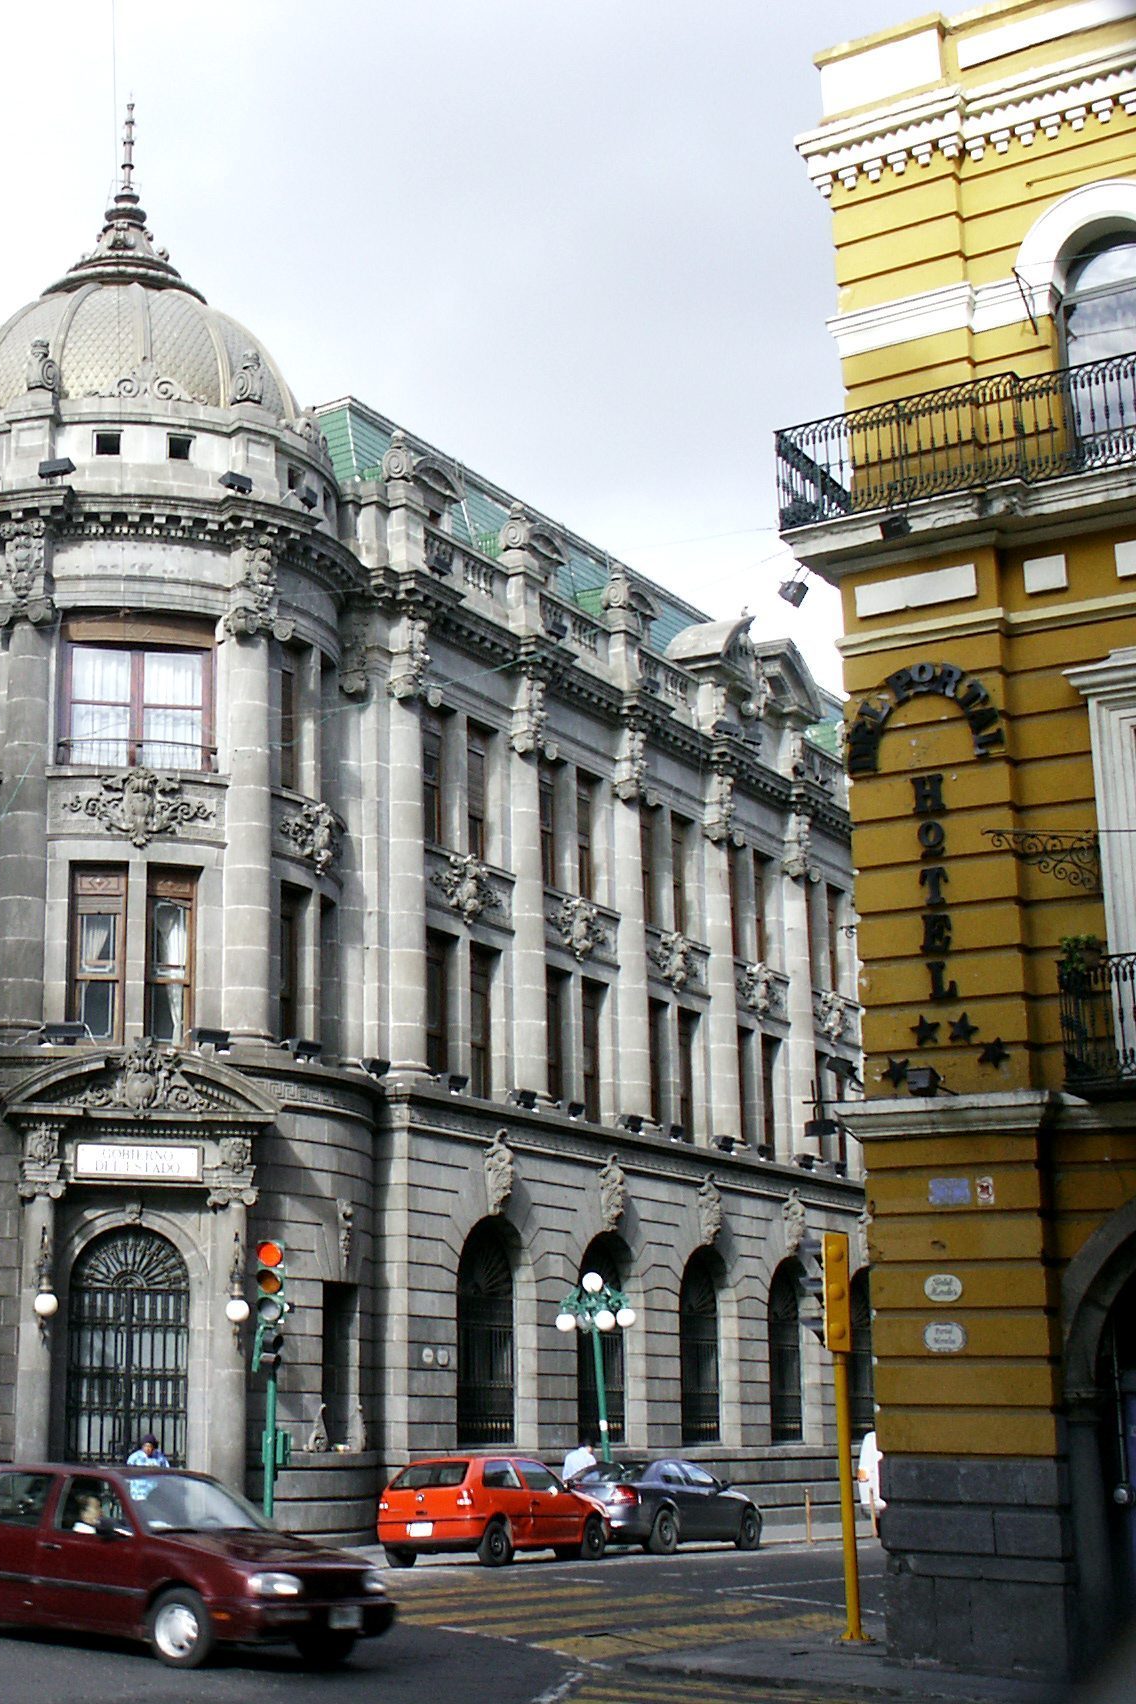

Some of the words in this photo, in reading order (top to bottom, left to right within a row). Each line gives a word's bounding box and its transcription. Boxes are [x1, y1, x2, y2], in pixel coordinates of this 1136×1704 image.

[102, 1148, 174, 1161] GOBIERNO
[95, 1160, 121, 1172] DEL
[126, 1161, 181, 1174] ESTADO
